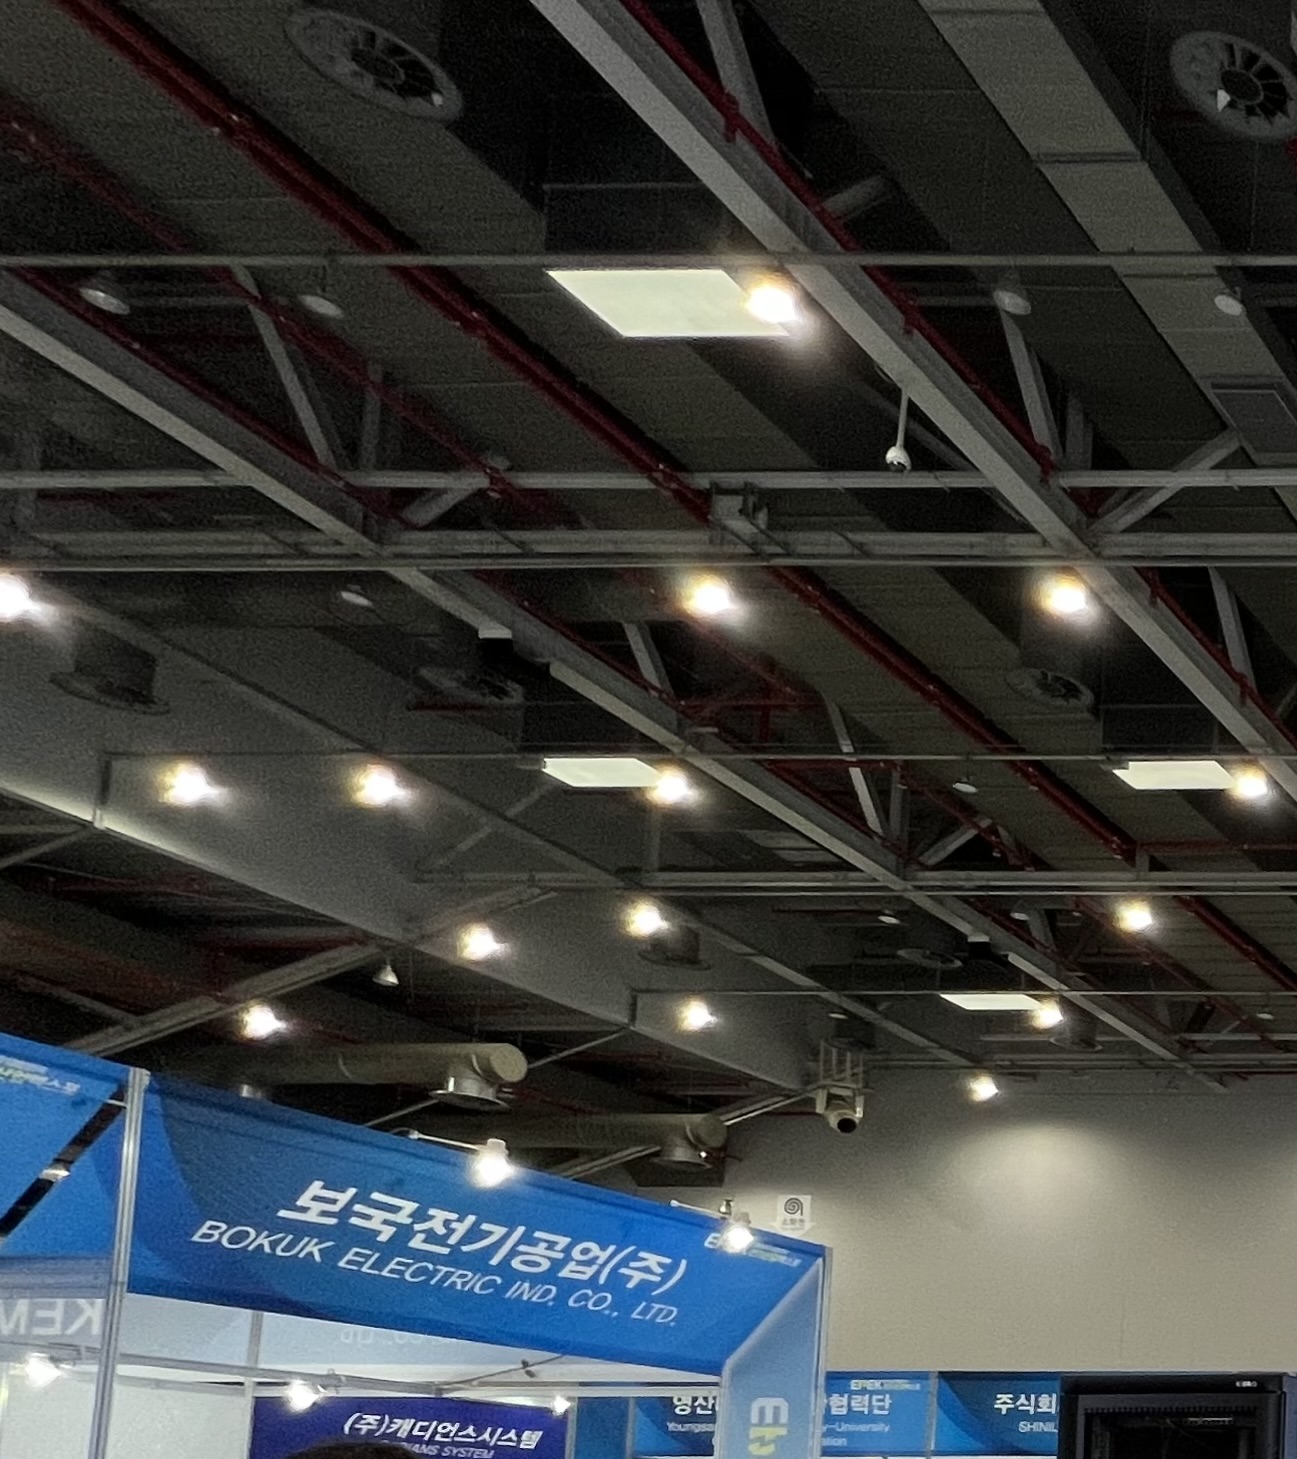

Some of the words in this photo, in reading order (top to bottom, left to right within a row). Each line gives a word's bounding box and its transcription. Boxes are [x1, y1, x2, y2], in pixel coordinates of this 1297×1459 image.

[277, 1180, 688, 1296] 보국전기공업(주)
[190, 1220, 336, 1263] BOKUK
[337, 1248, 503, 1296] ELECTRIC
[505, 1280, 556, 1307] IND.
[567, 1288, 620, 1319] CO.,
[630, 1300, 679, 1328] LTD.
[672, 1394, 720, 1415] 영산
[822, 1393, 893, 1416] 협력단
[343, 1412, 543, 1450] (주)캐디언스시스템
[441, 1446, 496, 1459] SYSTEM
